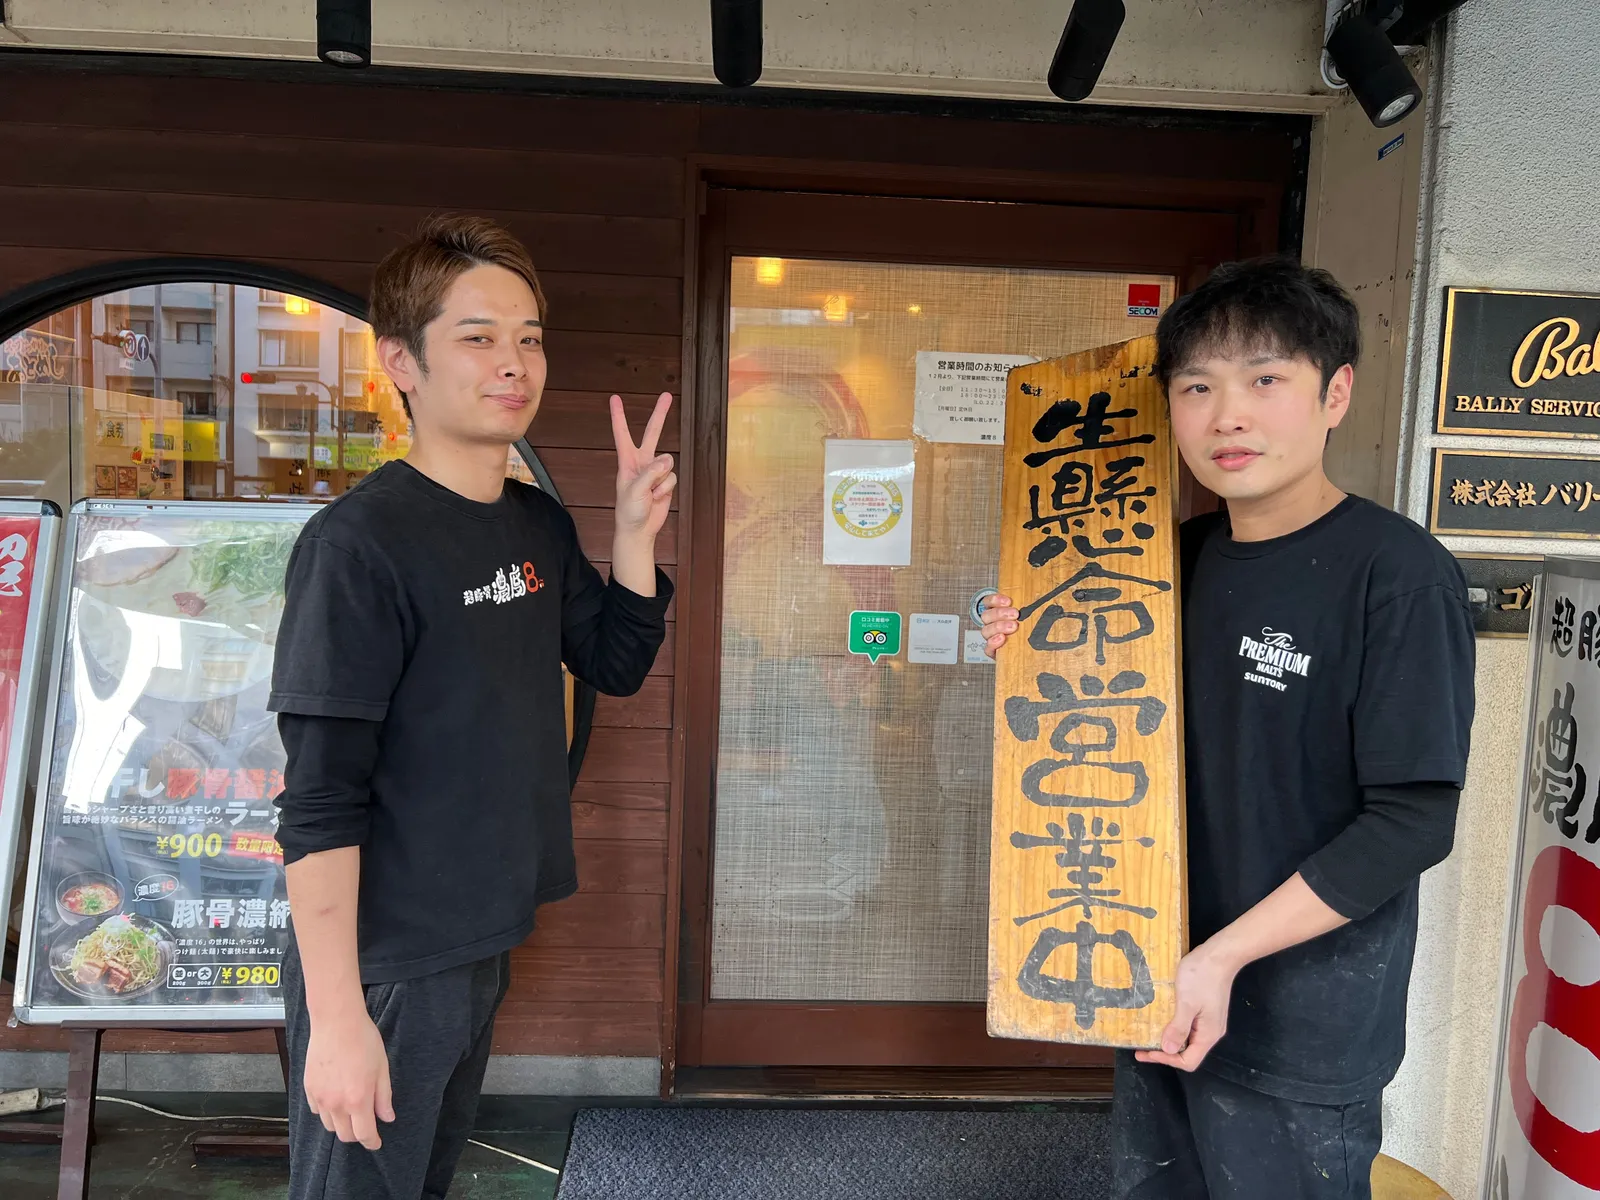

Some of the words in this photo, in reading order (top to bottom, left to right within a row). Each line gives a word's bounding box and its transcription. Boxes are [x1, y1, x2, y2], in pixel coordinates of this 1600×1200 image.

[1128, 306, 1158, 316] SECOM
[1455, 395, 1525, 414] BALLY
[1450, 479, 1537, 508] 株式会社
[1261, 626, 1297, 650] The
[1239, 635, 1312, 677] PREMIUM
[1256, 662, 1284, 678] MALTS
[1244, 672, 1288, 692] SUNTORY
[1531, 682, 1600, 844] 濃
[156, 833, 223, 858] ¥900
[221, 966, 278, 985] ¥980
